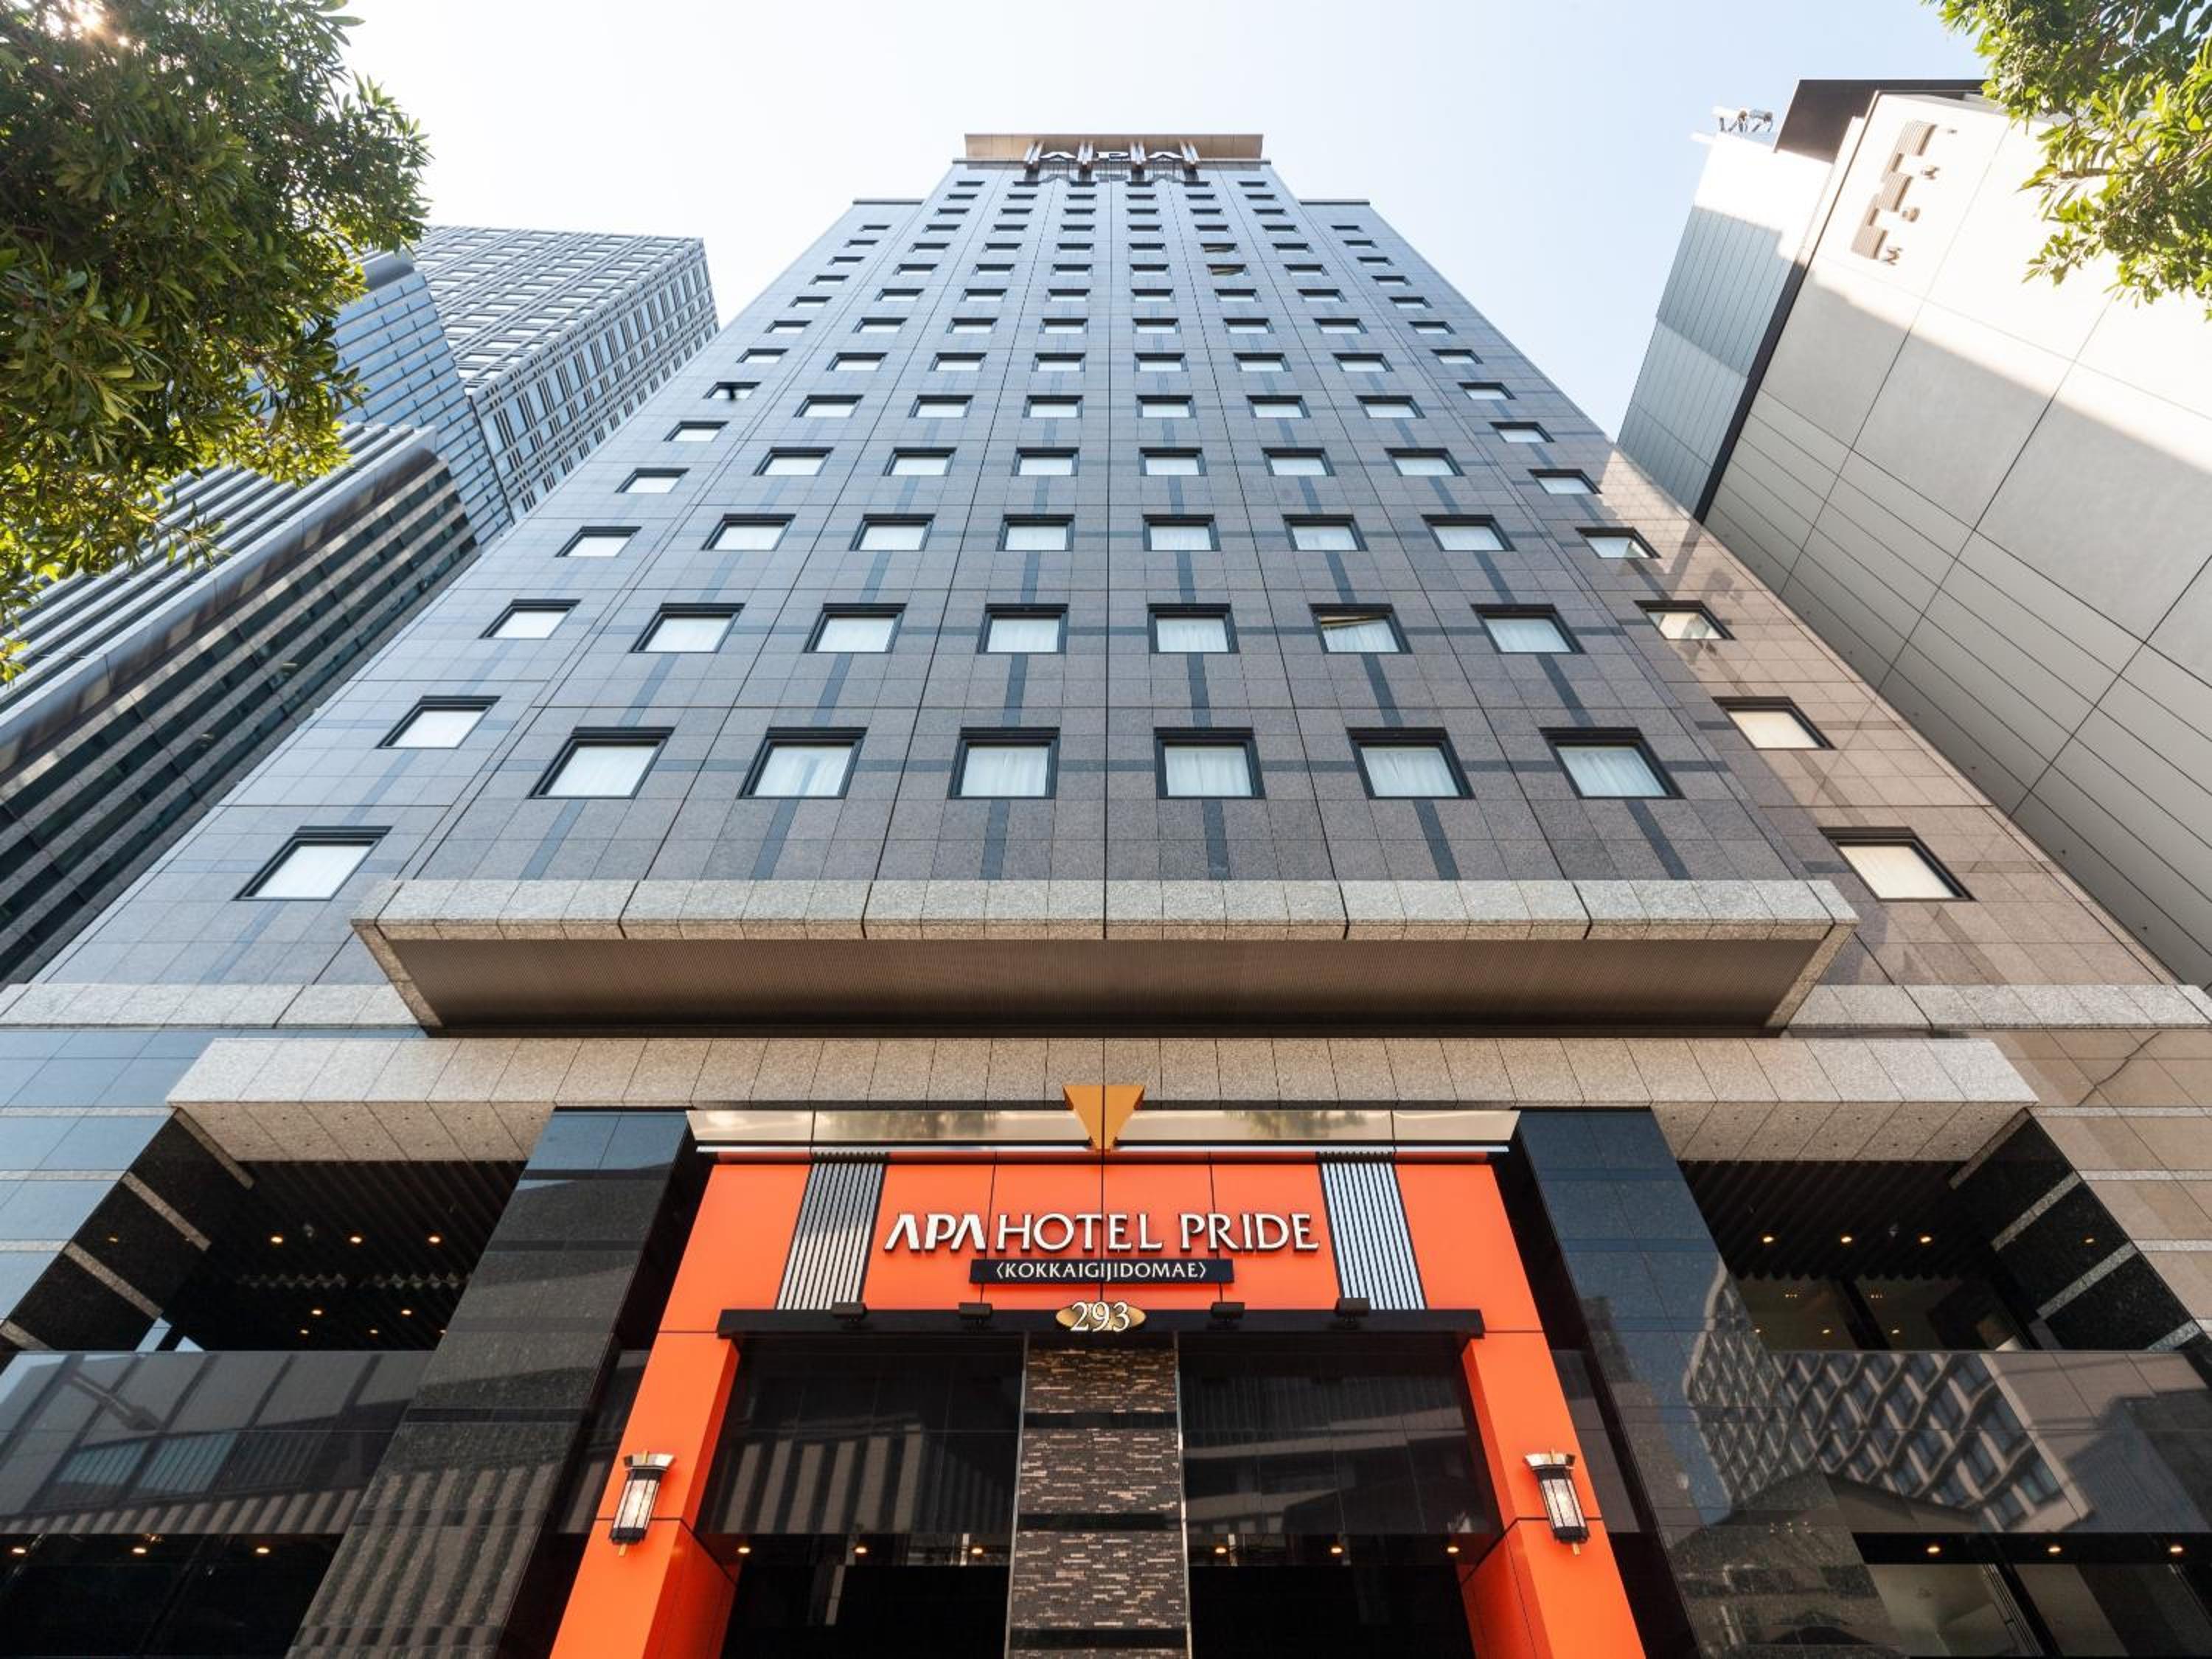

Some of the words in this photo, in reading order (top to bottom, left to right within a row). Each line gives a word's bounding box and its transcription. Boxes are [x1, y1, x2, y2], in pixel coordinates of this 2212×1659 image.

[885, 1214, 987, 1251] APA
[996, 1214, 1163, 1251] HOTEL
[1181, 1214, 1320, 1251] PRIDE
[1070, 1301, 1131, 1332] 293
